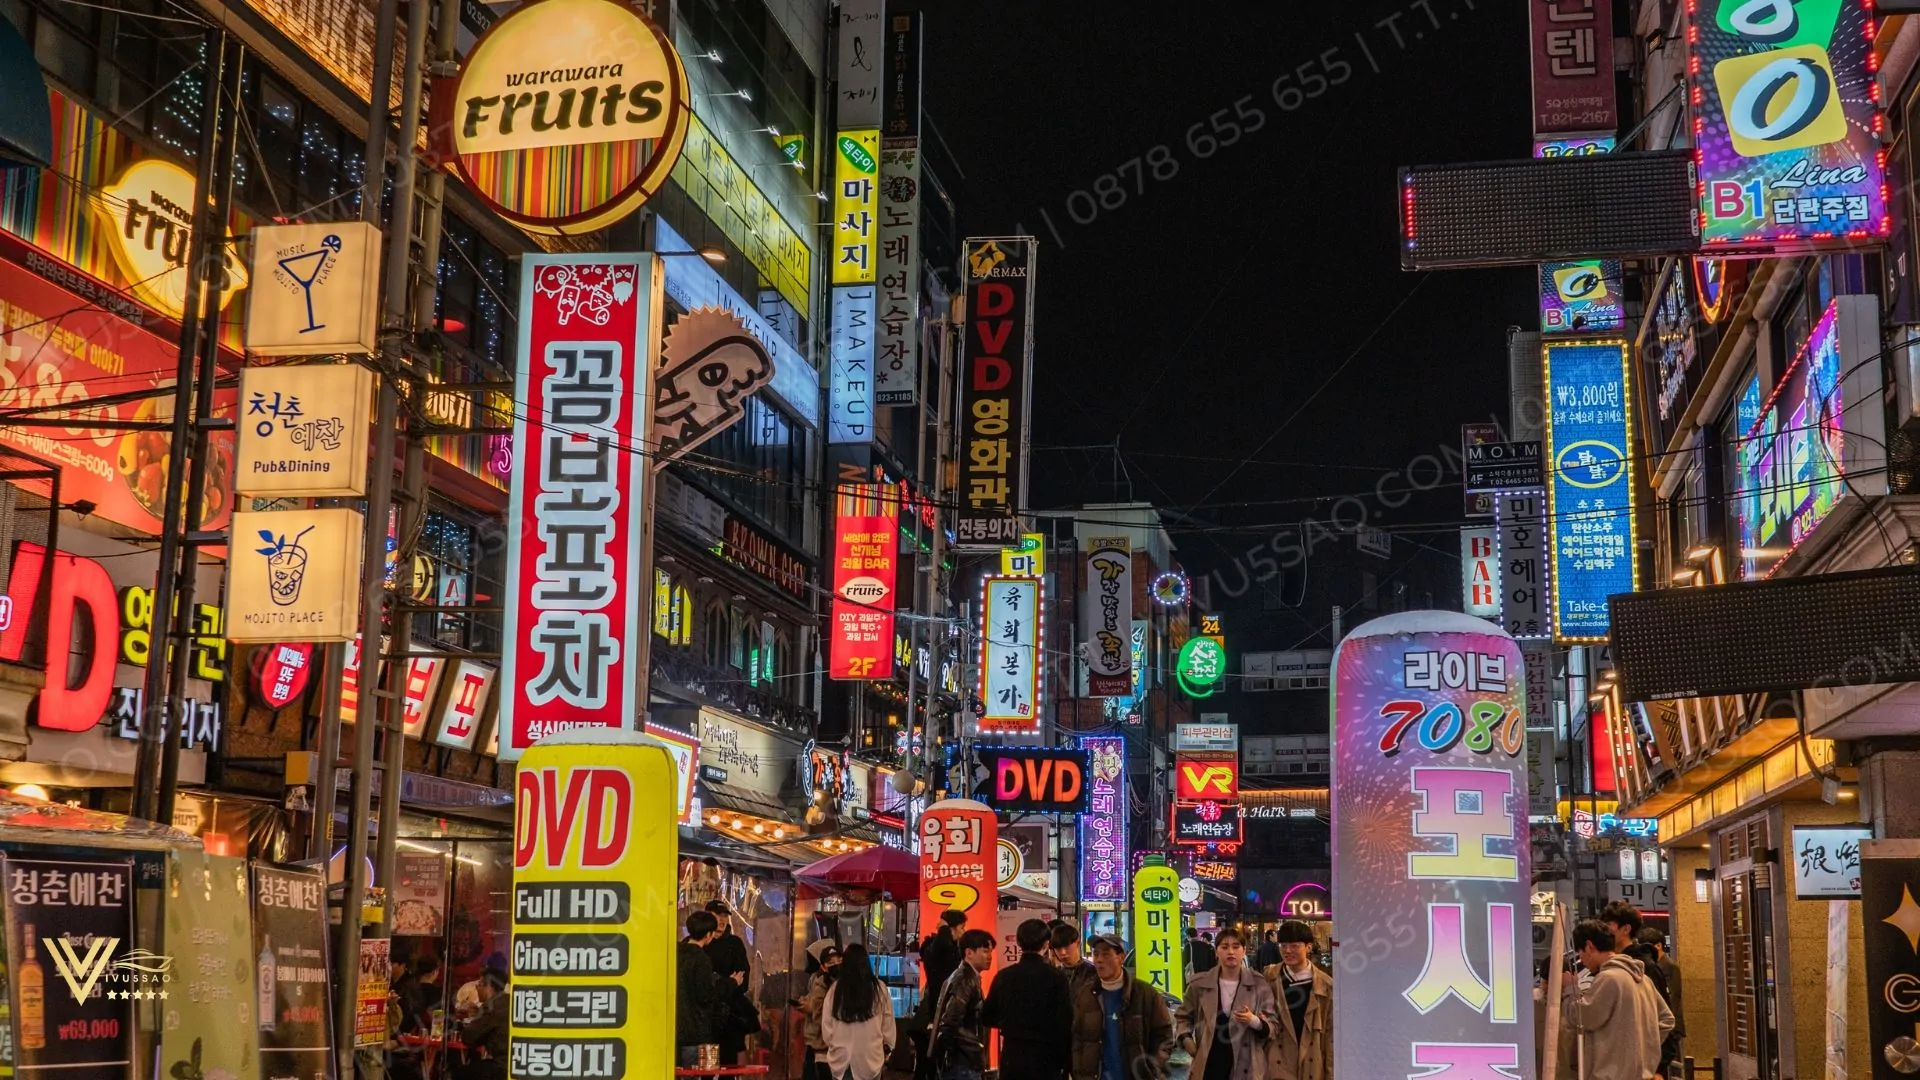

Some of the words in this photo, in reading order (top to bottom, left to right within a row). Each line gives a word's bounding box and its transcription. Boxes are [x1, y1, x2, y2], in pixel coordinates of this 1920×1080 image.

[506, 62, 624, 87] warawara
[462, 80, 665, 138] Fruits
[843, 139, 874, 173] 넥타이
[1769, 159, 1868, 189] Lina
[1711, 178, 1765, 220] B1
[1772, 195, 1870, 225] 단란주점
[840, 178, 874, 270] 마사지
[276, 243, 306, 259] MUSIC
[316, 256, 337, 286] PLACE
[881, 205, 914, 371] 노래연습장
[1545, 308, 1574, 327] B1
[973, 282, 1015, 391] DVD
[90, 343, 125, 376] 이야기
[247, 391, 304, 437] 청춘
[290, 416, 344, 451] 예찬
[253, 459, 331, 474] Pub&Dining
[526, 340, 624, 709] 꼼보포차
[959, 518, 1017, 540] 진동의자
[864, 558, 890, 569] BAR
[1470, 536, 1494, 606] BAR
[244, 612, 286, 624] MOJITO
[289, 611, 324, 623] PLACE
[1202, 621, 1220, 634] 24
[847, 657, 877, 676] 2F
[1404, 651, 1508, 694] 라이브
[117, 687, 221, 752] 진의자
[1181, 727, 1234, 739] 피부관리샵
[1379, 701, 1523, 756] 7080
[996, 757, 1082, 803] DVD
[1182, 766, 1234, 794] VR
[515, 765, 636, 872] DVD
[1092, 778, 1116, 880] 노래연습장
[1181, 822, 1234, 837] 노래연습장
[924, 816, 983, 863] 육회
[11, 869, 126, 908] 청춘예찬
[258, 874, 320, 912] 청춘예찬
[516, 889, 560, 918] Full
[569, 888, 619, 918] HD
[1096, 884, 1110, 896] B1
[1143, 889, 1171, 901] 넥타이
[1288, 900, 1325, 916] TOL
[514, 940, 621, 971] Cinema
[1146, 908, 1171, 993] 마사지
[512, 988, 617, 1025] 대형스크린
[511, 1042, 616, 1078] 진동의자
